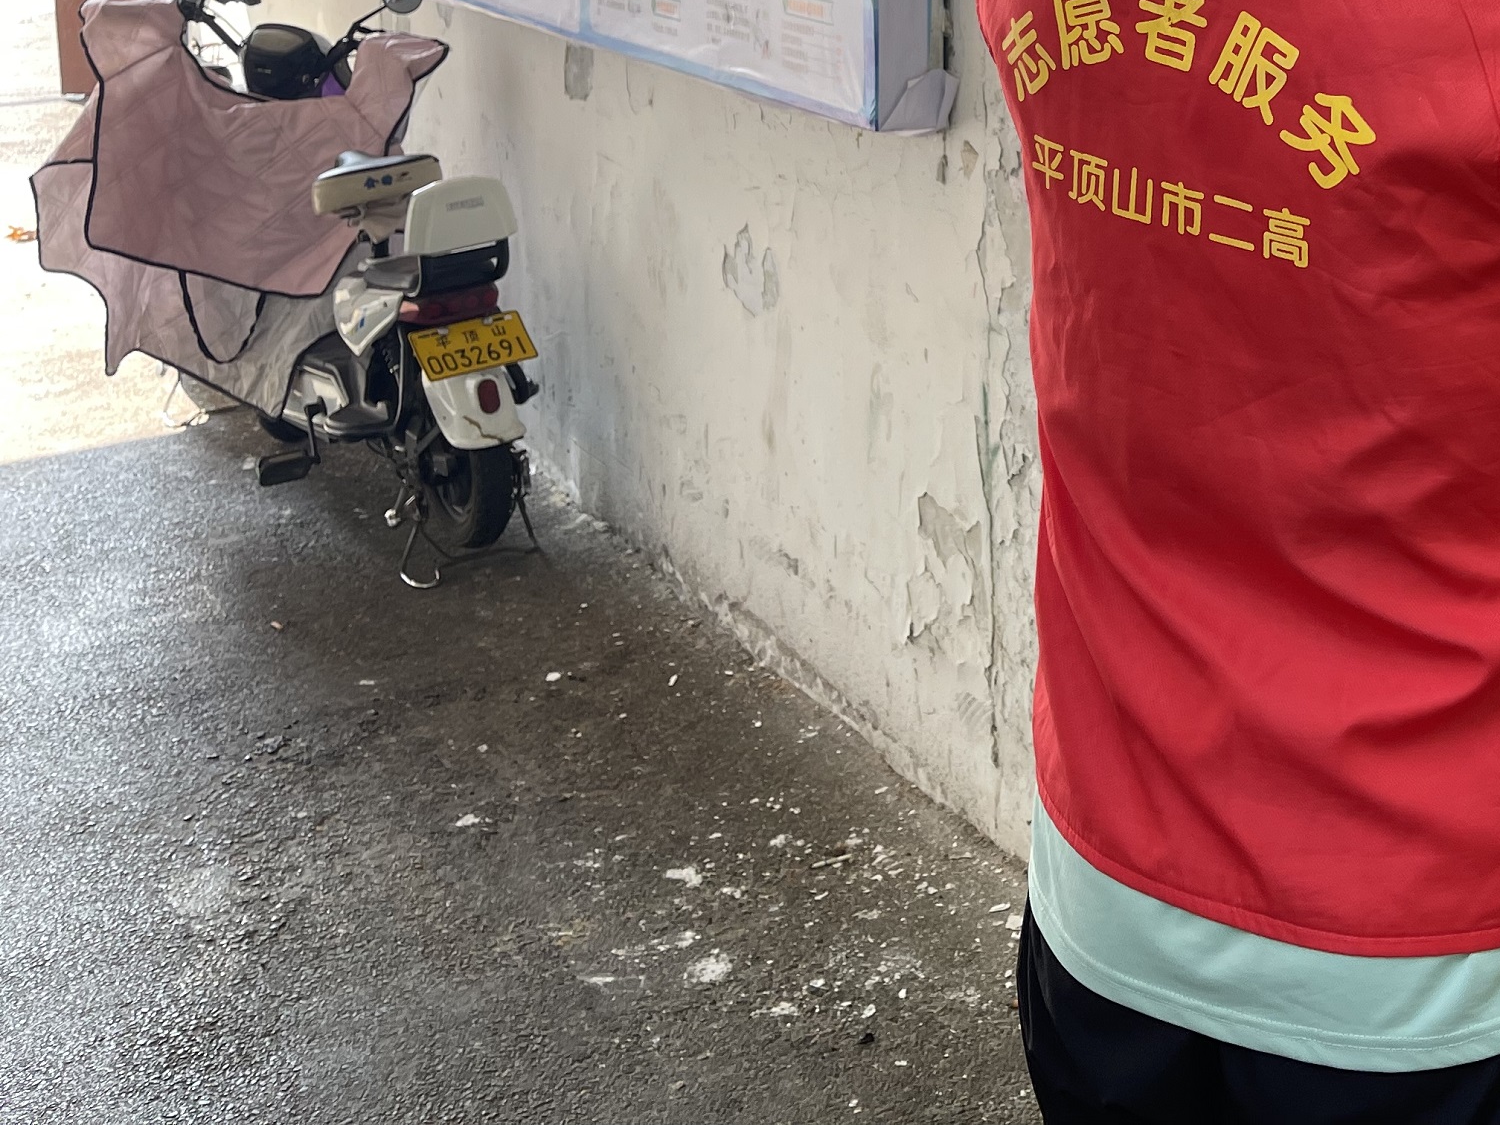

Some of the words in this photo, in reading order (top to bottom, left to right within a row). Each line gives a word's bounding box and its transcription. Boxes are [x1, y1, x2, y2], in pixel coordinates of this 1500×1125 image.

[1031, 134, 1312, 269] 平顶山市二高
[426, 335, 528, 375] 0032691
[435, 324, 507, 350] 平顶山
